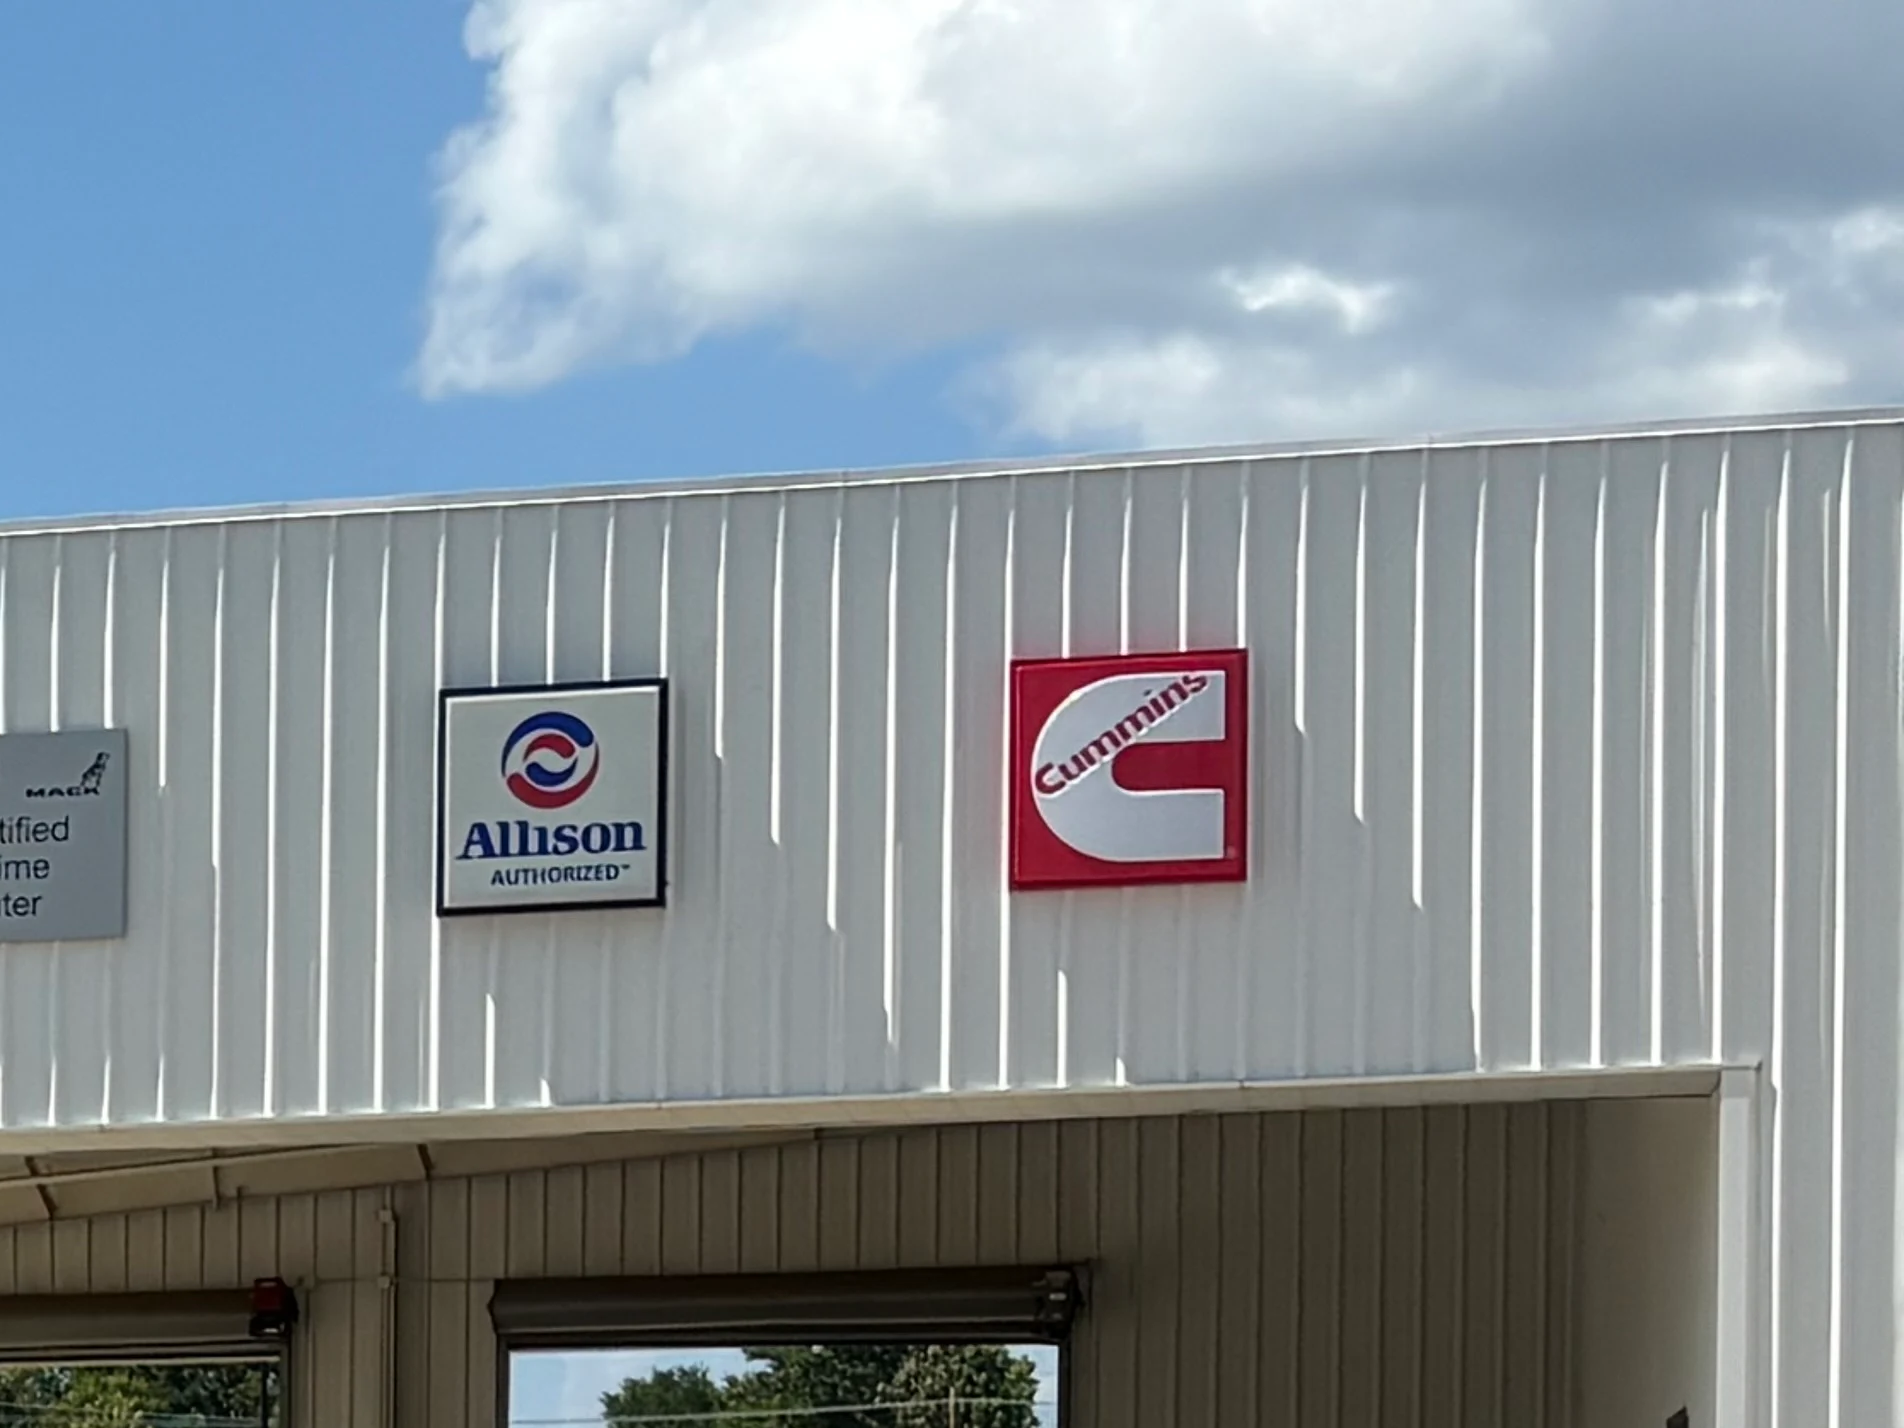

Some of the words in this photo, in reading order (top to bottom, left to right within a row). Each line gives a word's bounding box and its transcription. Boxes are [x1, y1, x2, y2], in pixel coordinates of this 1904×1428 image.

[1034, 674, 1210, 795] Cummins
[25, 786, 100, 798] MACK
[455, 820, 647, 860] Allison
